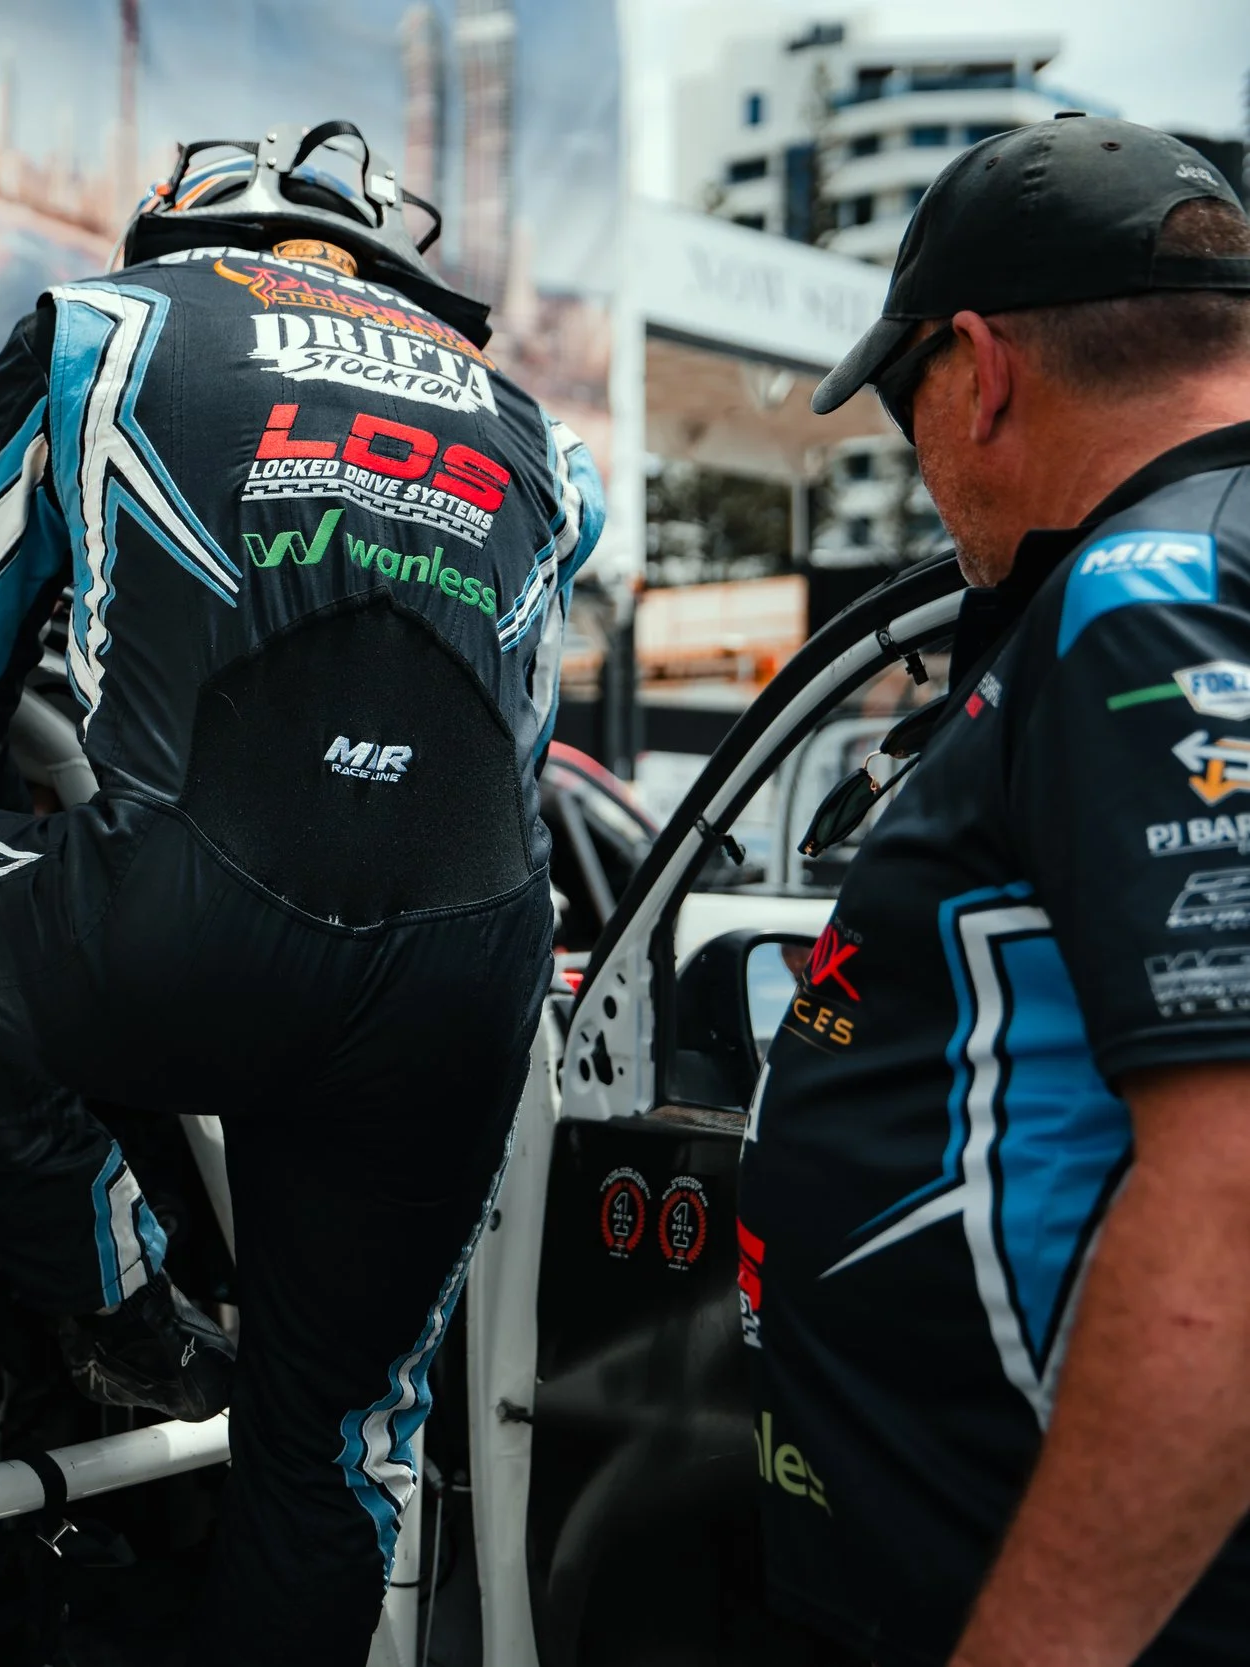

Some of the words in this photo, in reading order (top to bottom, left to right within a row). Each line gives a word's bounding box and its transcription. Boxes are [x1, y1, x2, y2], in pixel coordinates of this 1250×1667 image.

[250, 313, 500, 417] DRIFTA
[293, 351, 469, 402] STOCKTON
[248, 459, 340, 480] LOCKED
[343, 465, 404, 499] DRIVE
[402, 482, 495, 531] SYSTEMS
[254, 404, 511, 513] LDS
[346, 532, 498, 617] wanless
[1080, 542, 1199, 576] MIR
